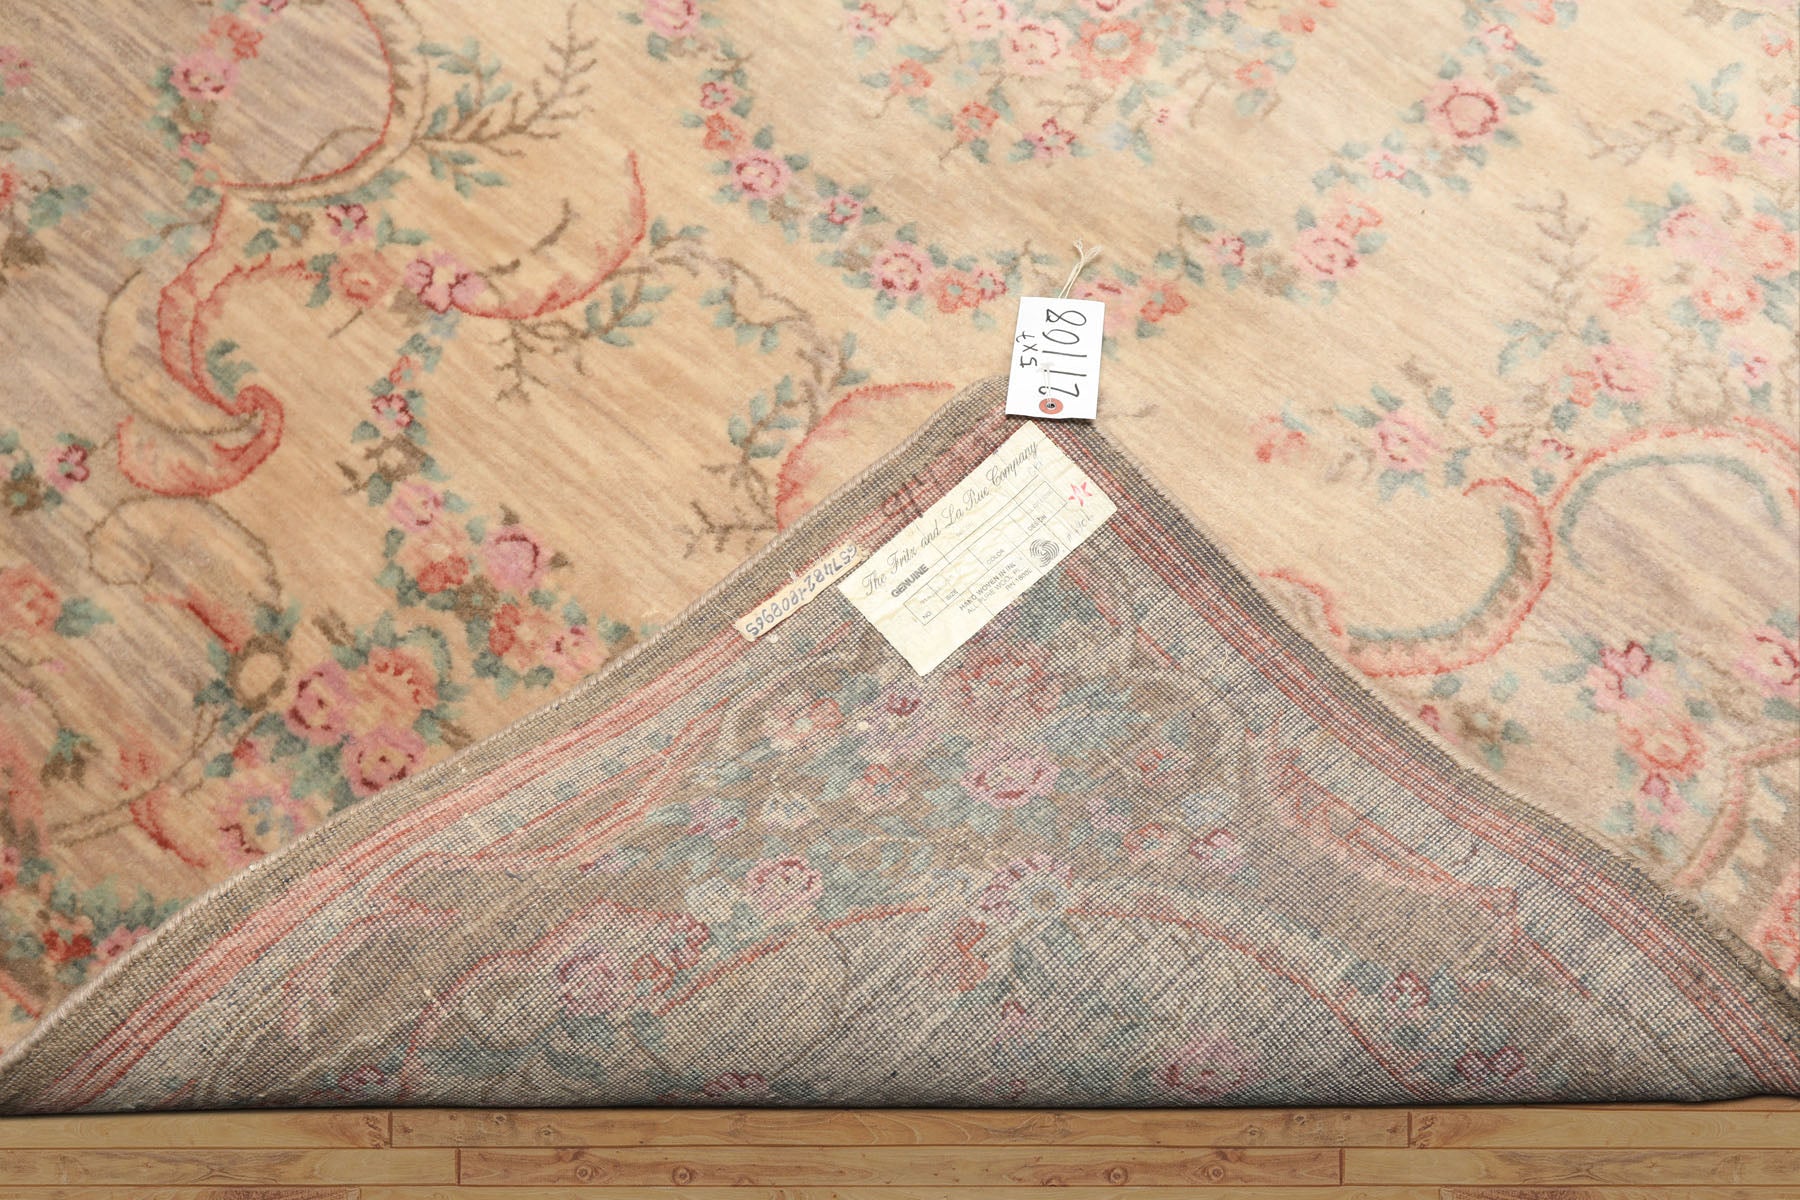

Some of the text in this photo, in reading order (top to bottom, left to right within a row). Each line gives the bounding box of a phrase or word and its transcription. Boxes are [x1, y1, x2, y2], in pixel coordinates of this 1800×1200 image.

[861, 570, 888, 597] The
[886, 546, 917, 575] Fritz
[920, 519, 942, 549] and
[940, 503, 964, 528] La
[962, 486, 990, 511] Rue
[985, 441, 1039, 487] Company
[890, 563, 930, 598] GENUINE
[959, 594, 978, 611] HAND
[975, 575, 1000, 596] WOVEN
